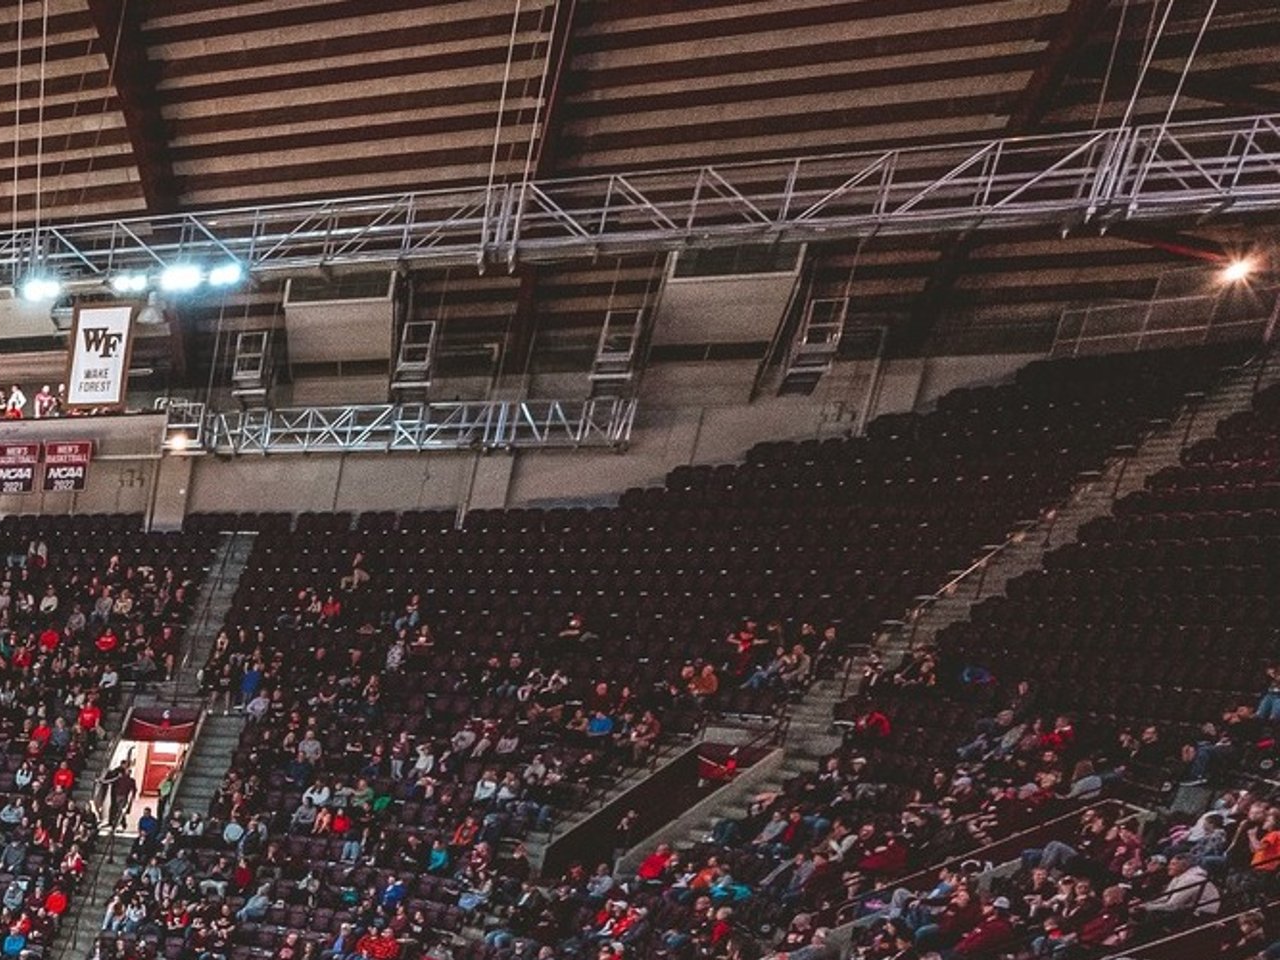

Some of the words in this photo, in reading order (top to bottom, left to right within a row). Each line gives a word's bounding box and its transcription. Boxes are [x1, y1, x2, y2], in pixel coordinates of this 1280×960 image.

[83, 327, 123, 357] WF
[84, 368, 109, 378] WAKE
[78, 381, 111, 392] FOREST
[57, 445, 79, 454] MEN'S
[46, 454, 87, 462] BASKETBALL
[48, 466, 83, 479] NCAA
